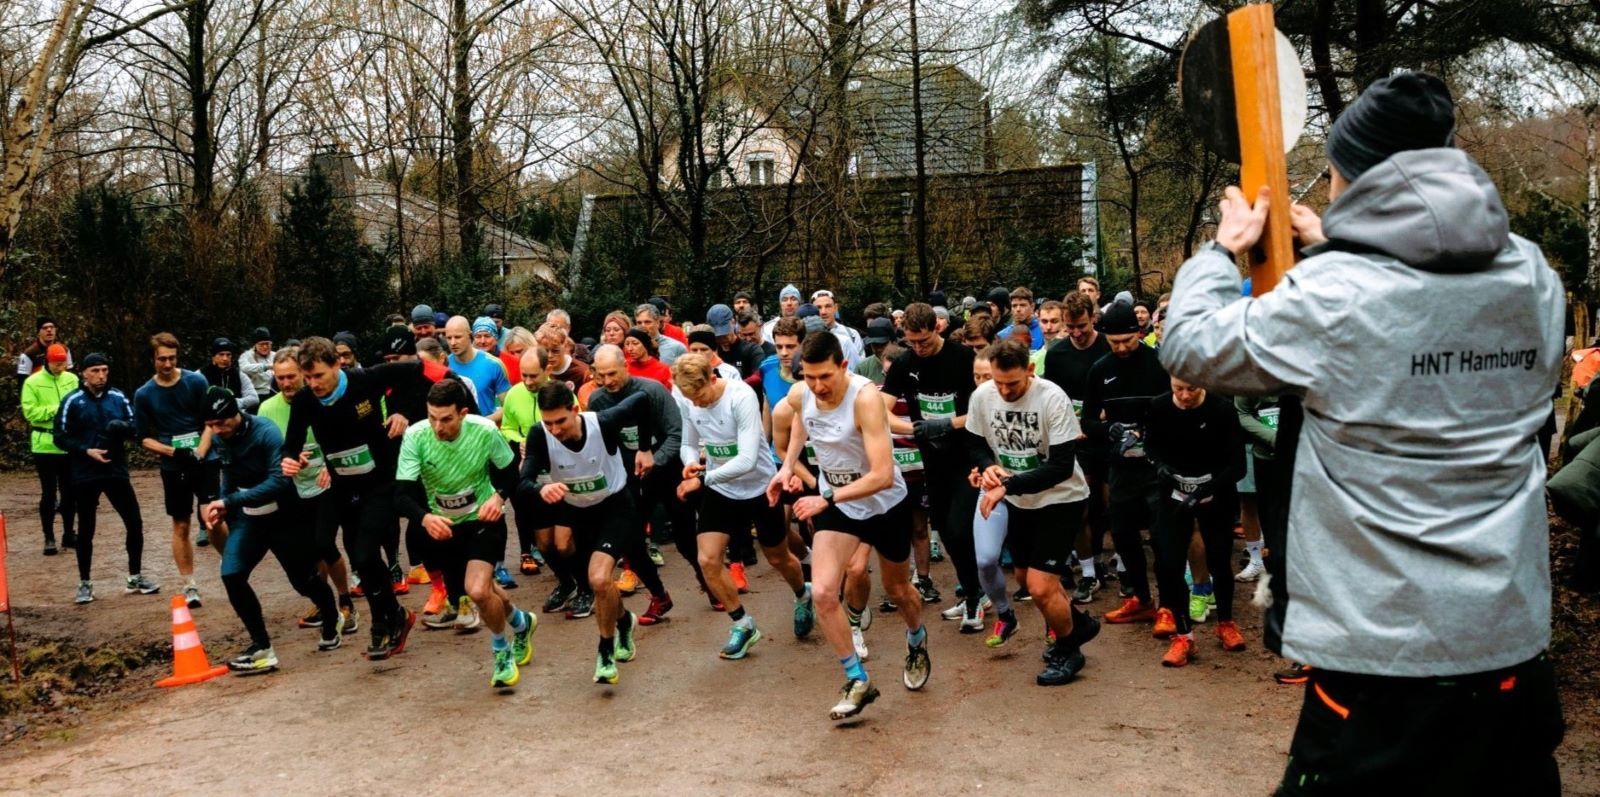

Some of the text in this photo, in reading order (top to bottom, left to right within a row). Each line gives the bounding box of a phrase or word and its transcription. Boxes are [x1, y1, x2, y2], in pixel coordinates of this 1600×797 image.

[1411, 347, 1538, 376] HNT Hamburg
[926, 402, 944, 411] 444
[1268, 415, 1279, 426] 36
[713, 446, 731, 456] 418
[341, 454, 359, 466] 417
[898, 453, 915, 463] 318
[1008, 457, 1029, 468] 354
[827, 473, 853, 485] 1042
[573, 481, 595, 492] 419
[440, 496, 467, 510] 1044
